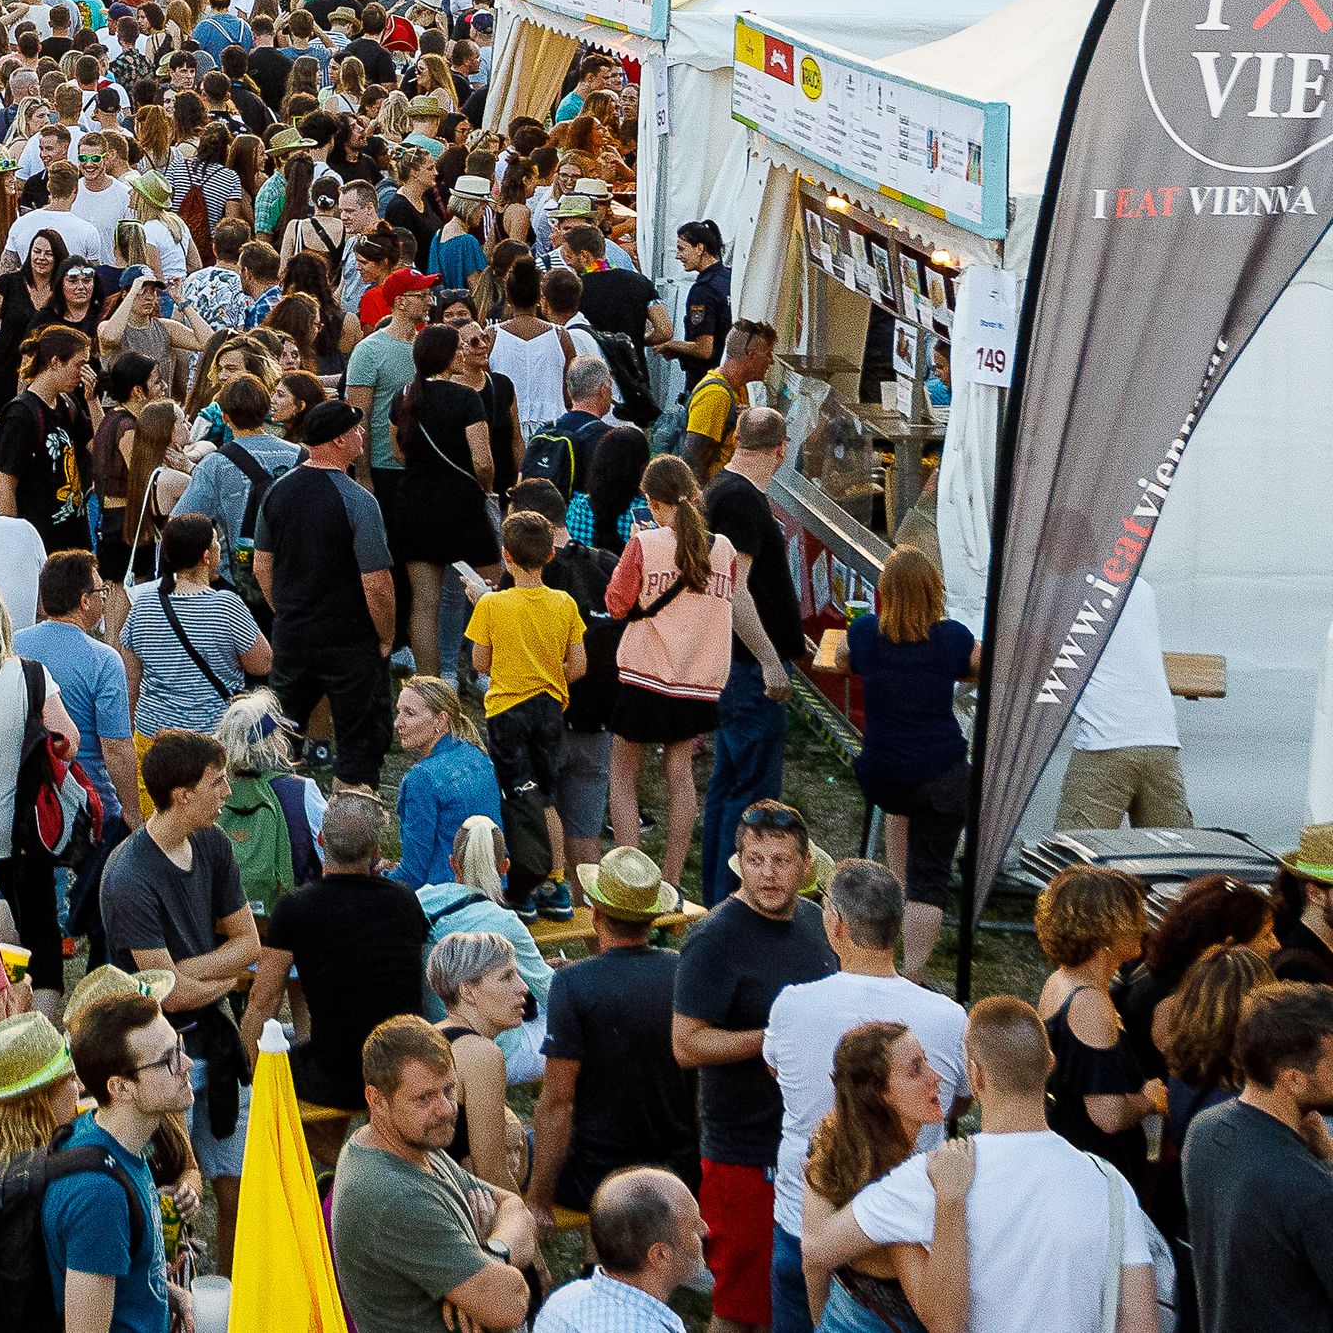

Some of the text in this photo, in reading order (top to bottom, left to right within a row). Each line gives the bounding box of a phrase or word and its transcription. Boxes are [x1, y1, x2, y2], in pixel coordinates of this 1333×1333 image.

[1191, 51, 1332, 119] VIE
[1092, 185, 1318, 220] I EAT VIENNA
[977, 347, 1006, 374] 149
